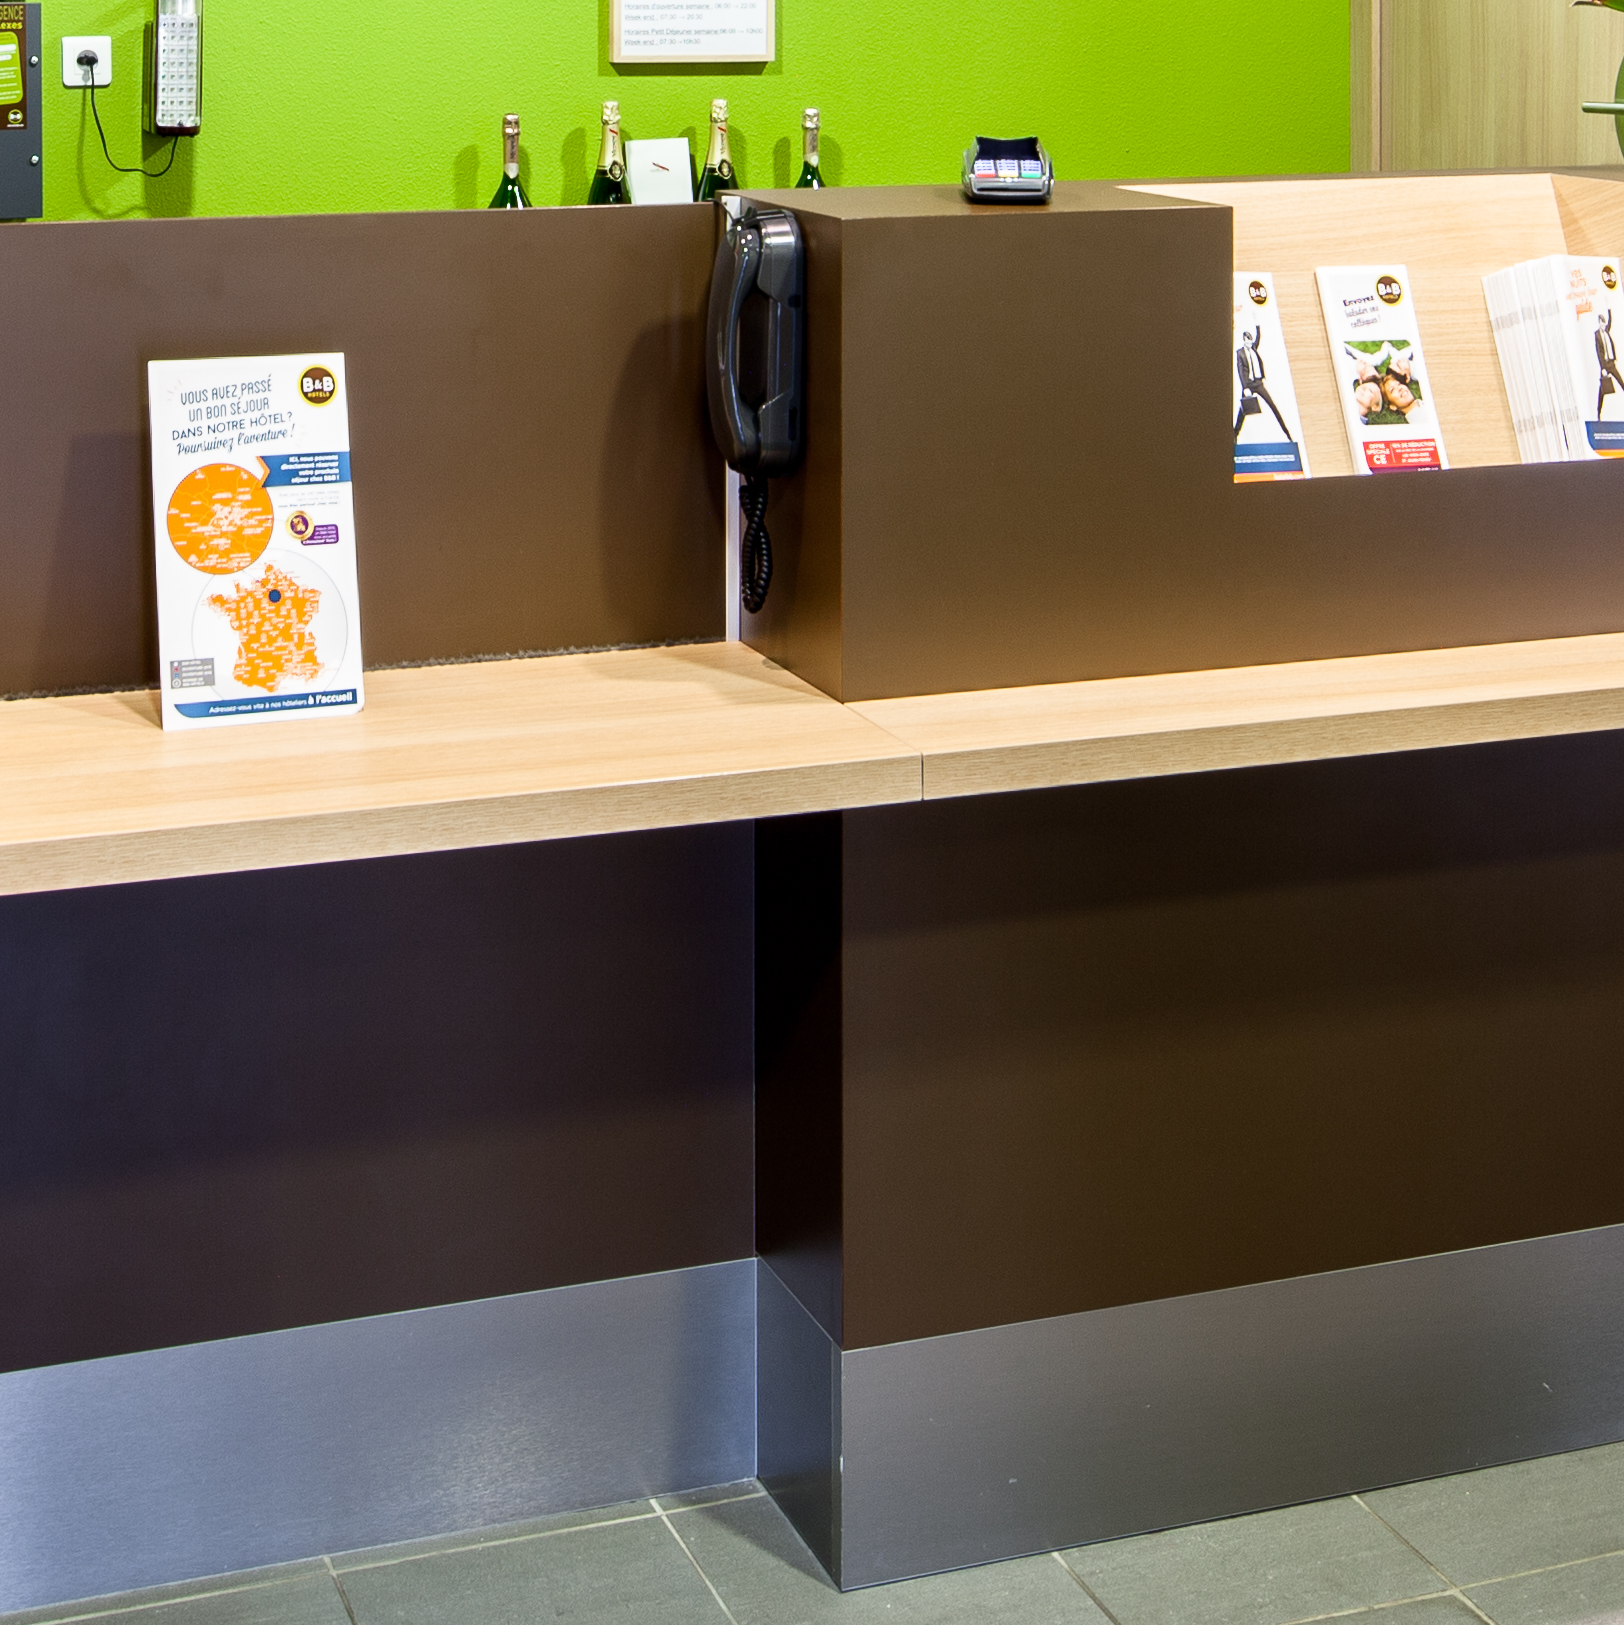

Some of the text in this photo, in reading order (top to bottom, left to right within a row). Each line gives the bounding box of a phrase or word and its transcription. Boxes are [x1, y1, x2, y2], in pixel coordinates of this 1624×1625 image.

[1378, 283, 1401, 295] B&B
[1343, 295, 1374, 307] Envoyez
[180, 374, 272, 405] VOUS AVEZ PASSÉ
[303, 376, 334, 392] B&B
[188, 397, 270, 422] UN BON SÉJOUR
[172, 425, 202, 441] DANS
[207, 419, 245, 435] NOTRE
[177, 435, 234, 456] Poursuivez
[1373, 455, 1387, 464] CE
[209, 702, 251, 714] Adressez-vous
[316, 691, 353, 704] l'accueil
